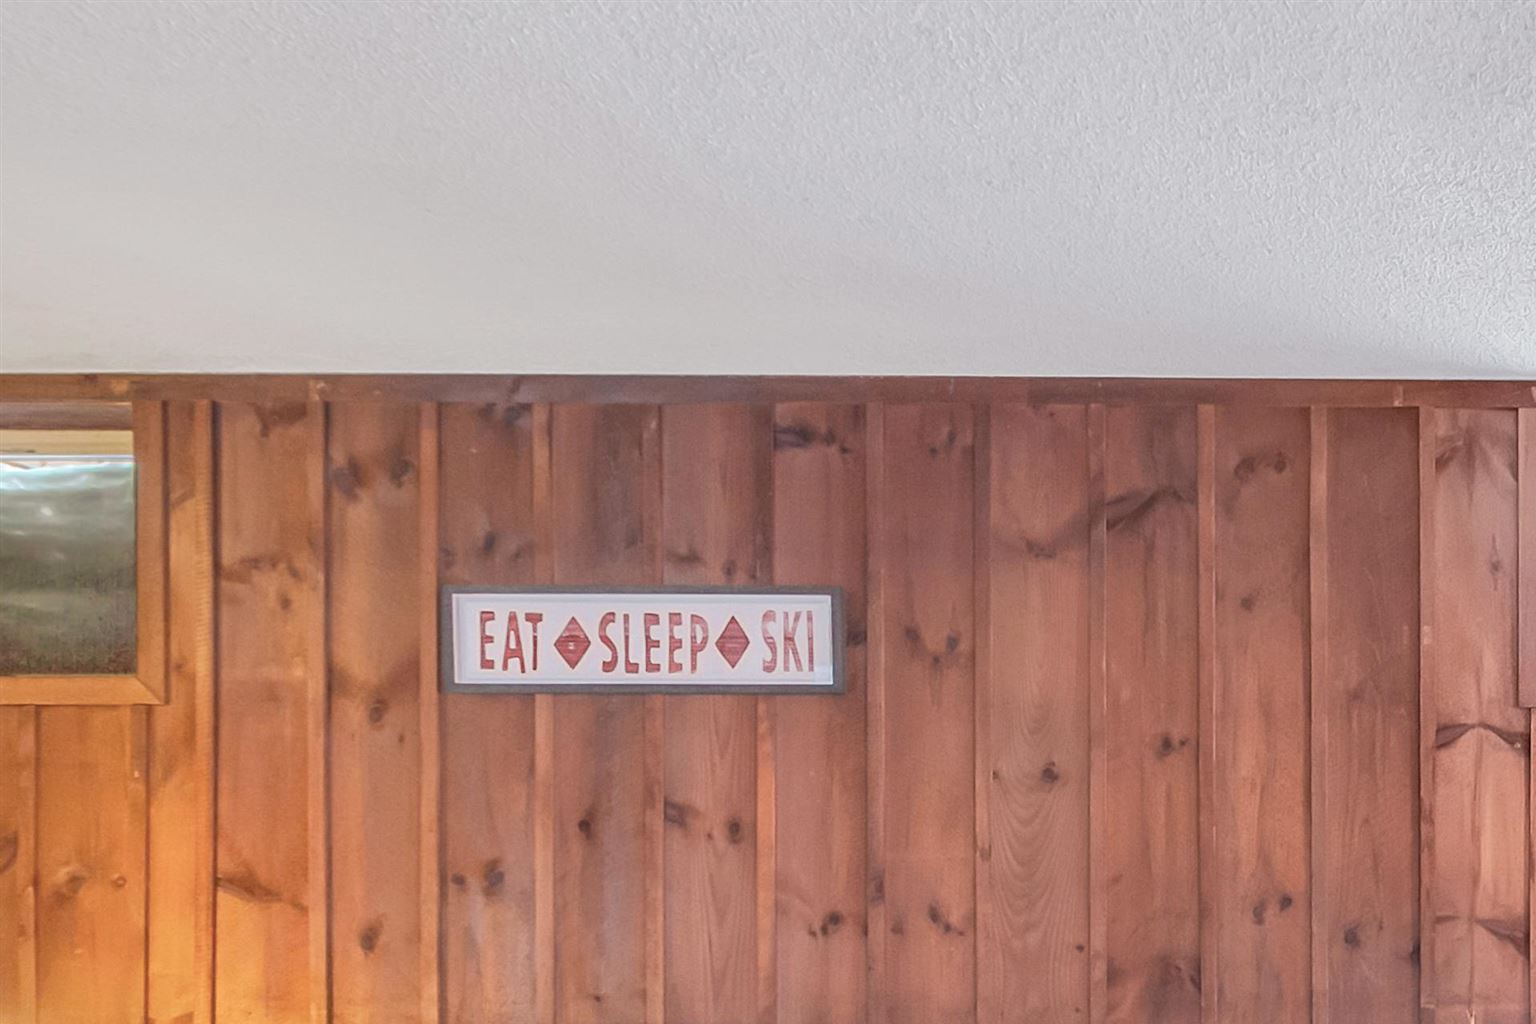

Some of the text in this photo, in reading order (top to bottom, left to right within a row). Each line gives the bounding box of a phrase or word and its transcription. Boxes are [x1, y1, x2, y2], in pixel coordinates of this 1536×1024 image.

[479, 609, 815, 674] EAT SLEEP SKI
